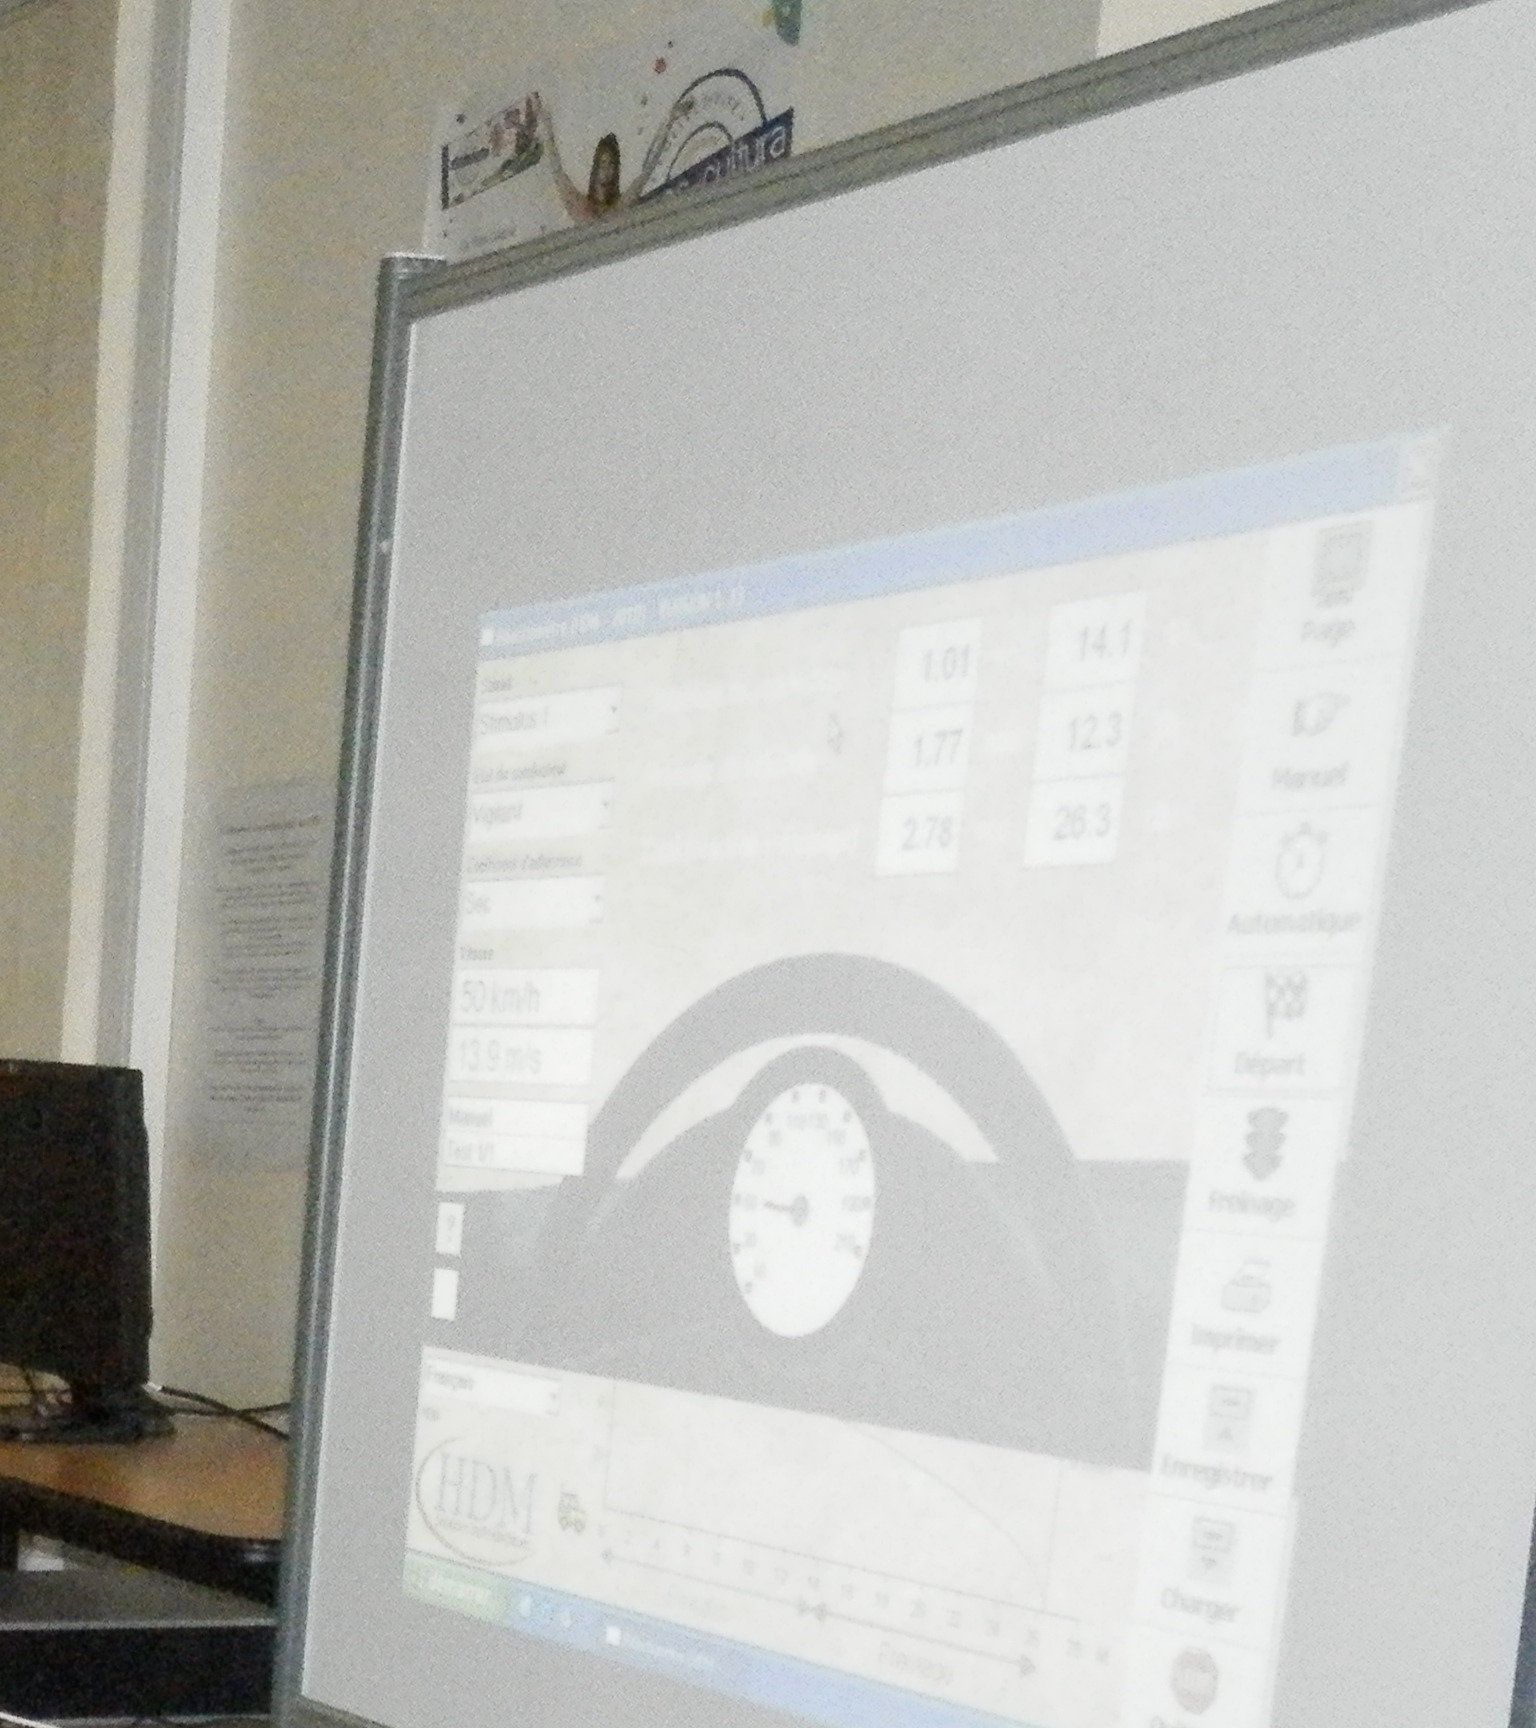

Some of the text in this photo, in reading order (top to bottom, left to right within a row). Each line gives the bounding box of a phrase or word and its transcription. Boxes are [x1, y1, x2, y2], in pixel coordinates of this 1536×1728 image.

[1078, 618, 1133, 662] 14.1
[913, 727, 965, 768] 1.77
[1066, 710, 1124, 753] 12.3
[434, 1453, 537, 1536] HDM
